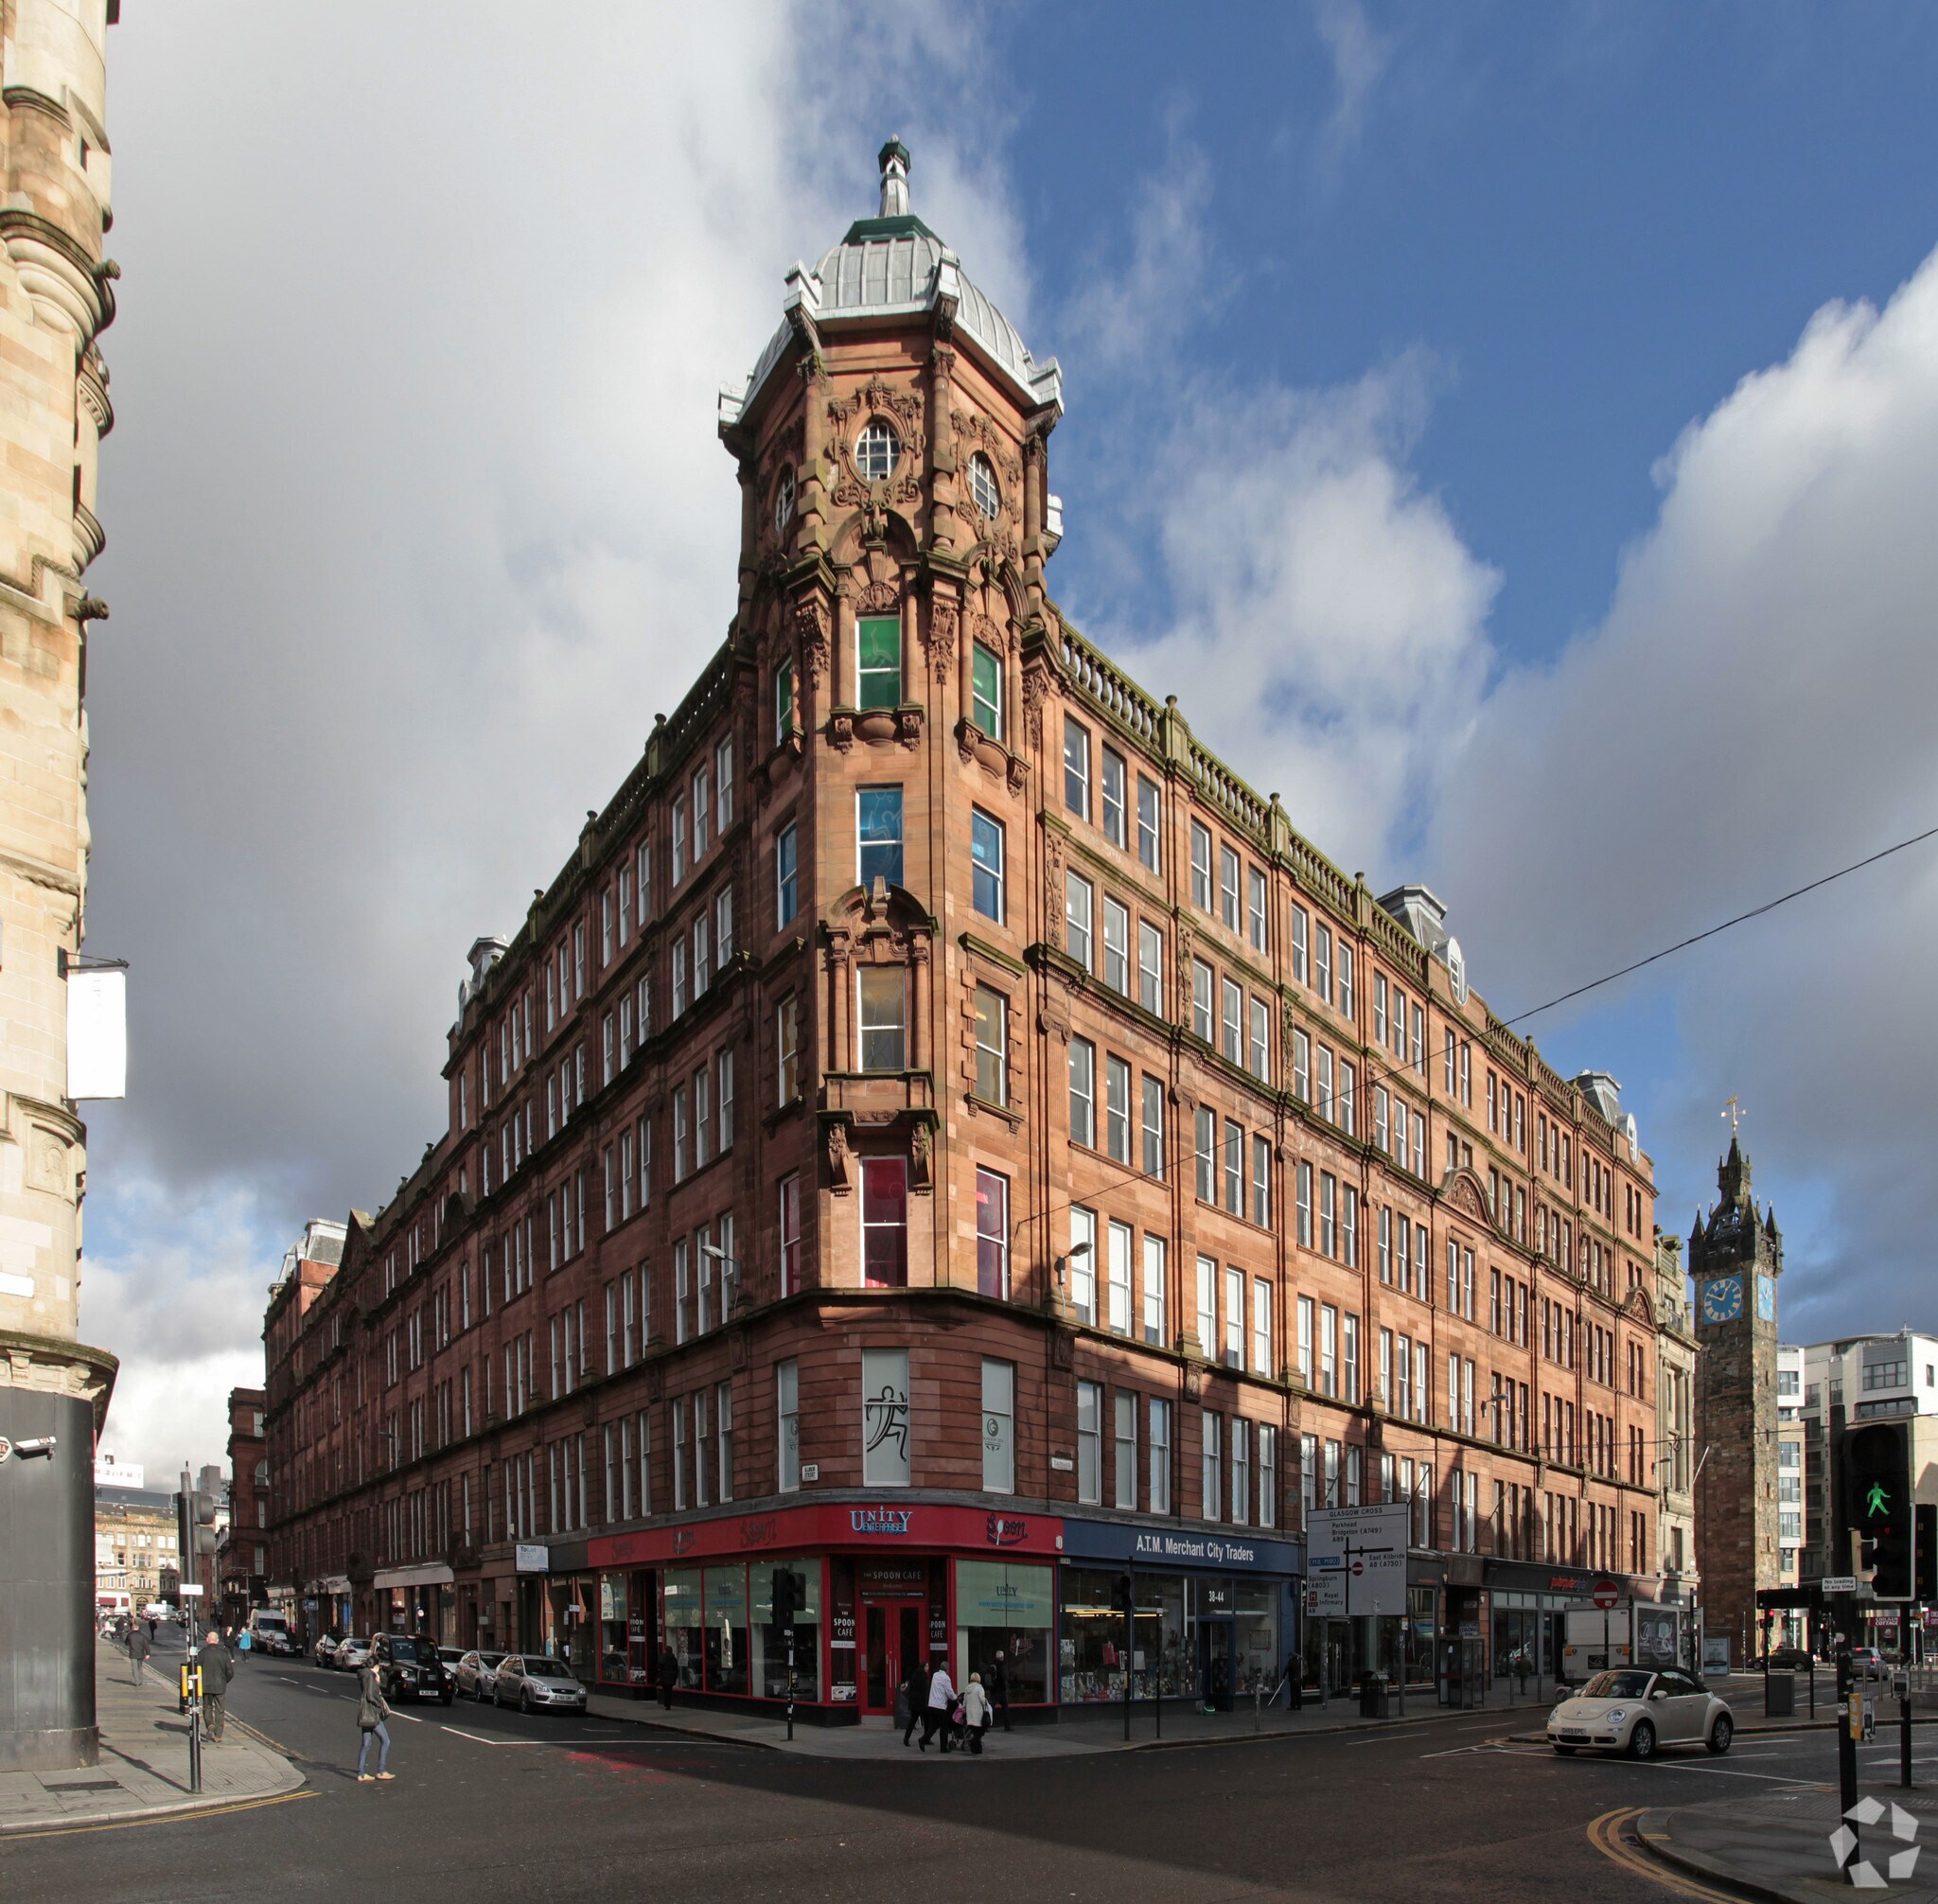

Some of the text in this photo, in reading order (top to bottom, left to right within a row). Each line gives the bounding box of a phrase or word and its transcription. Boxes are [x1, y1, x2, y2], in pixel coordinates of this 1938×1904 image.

[863, 1523, 904, 1532] ENTERPRISE
[1136, 1535, 1254, 1561] A.T.M. Merchant City Traders
[903, 1570, 921, 1579] CAFÉ
[1209, 1591, 1224, 1602] 38-44
[834, 1618, 855, 1627] SPOON
[837, 1628, 853, 1636] CAFÉ
[931, 1630, 943, 1638] CAFÉ
